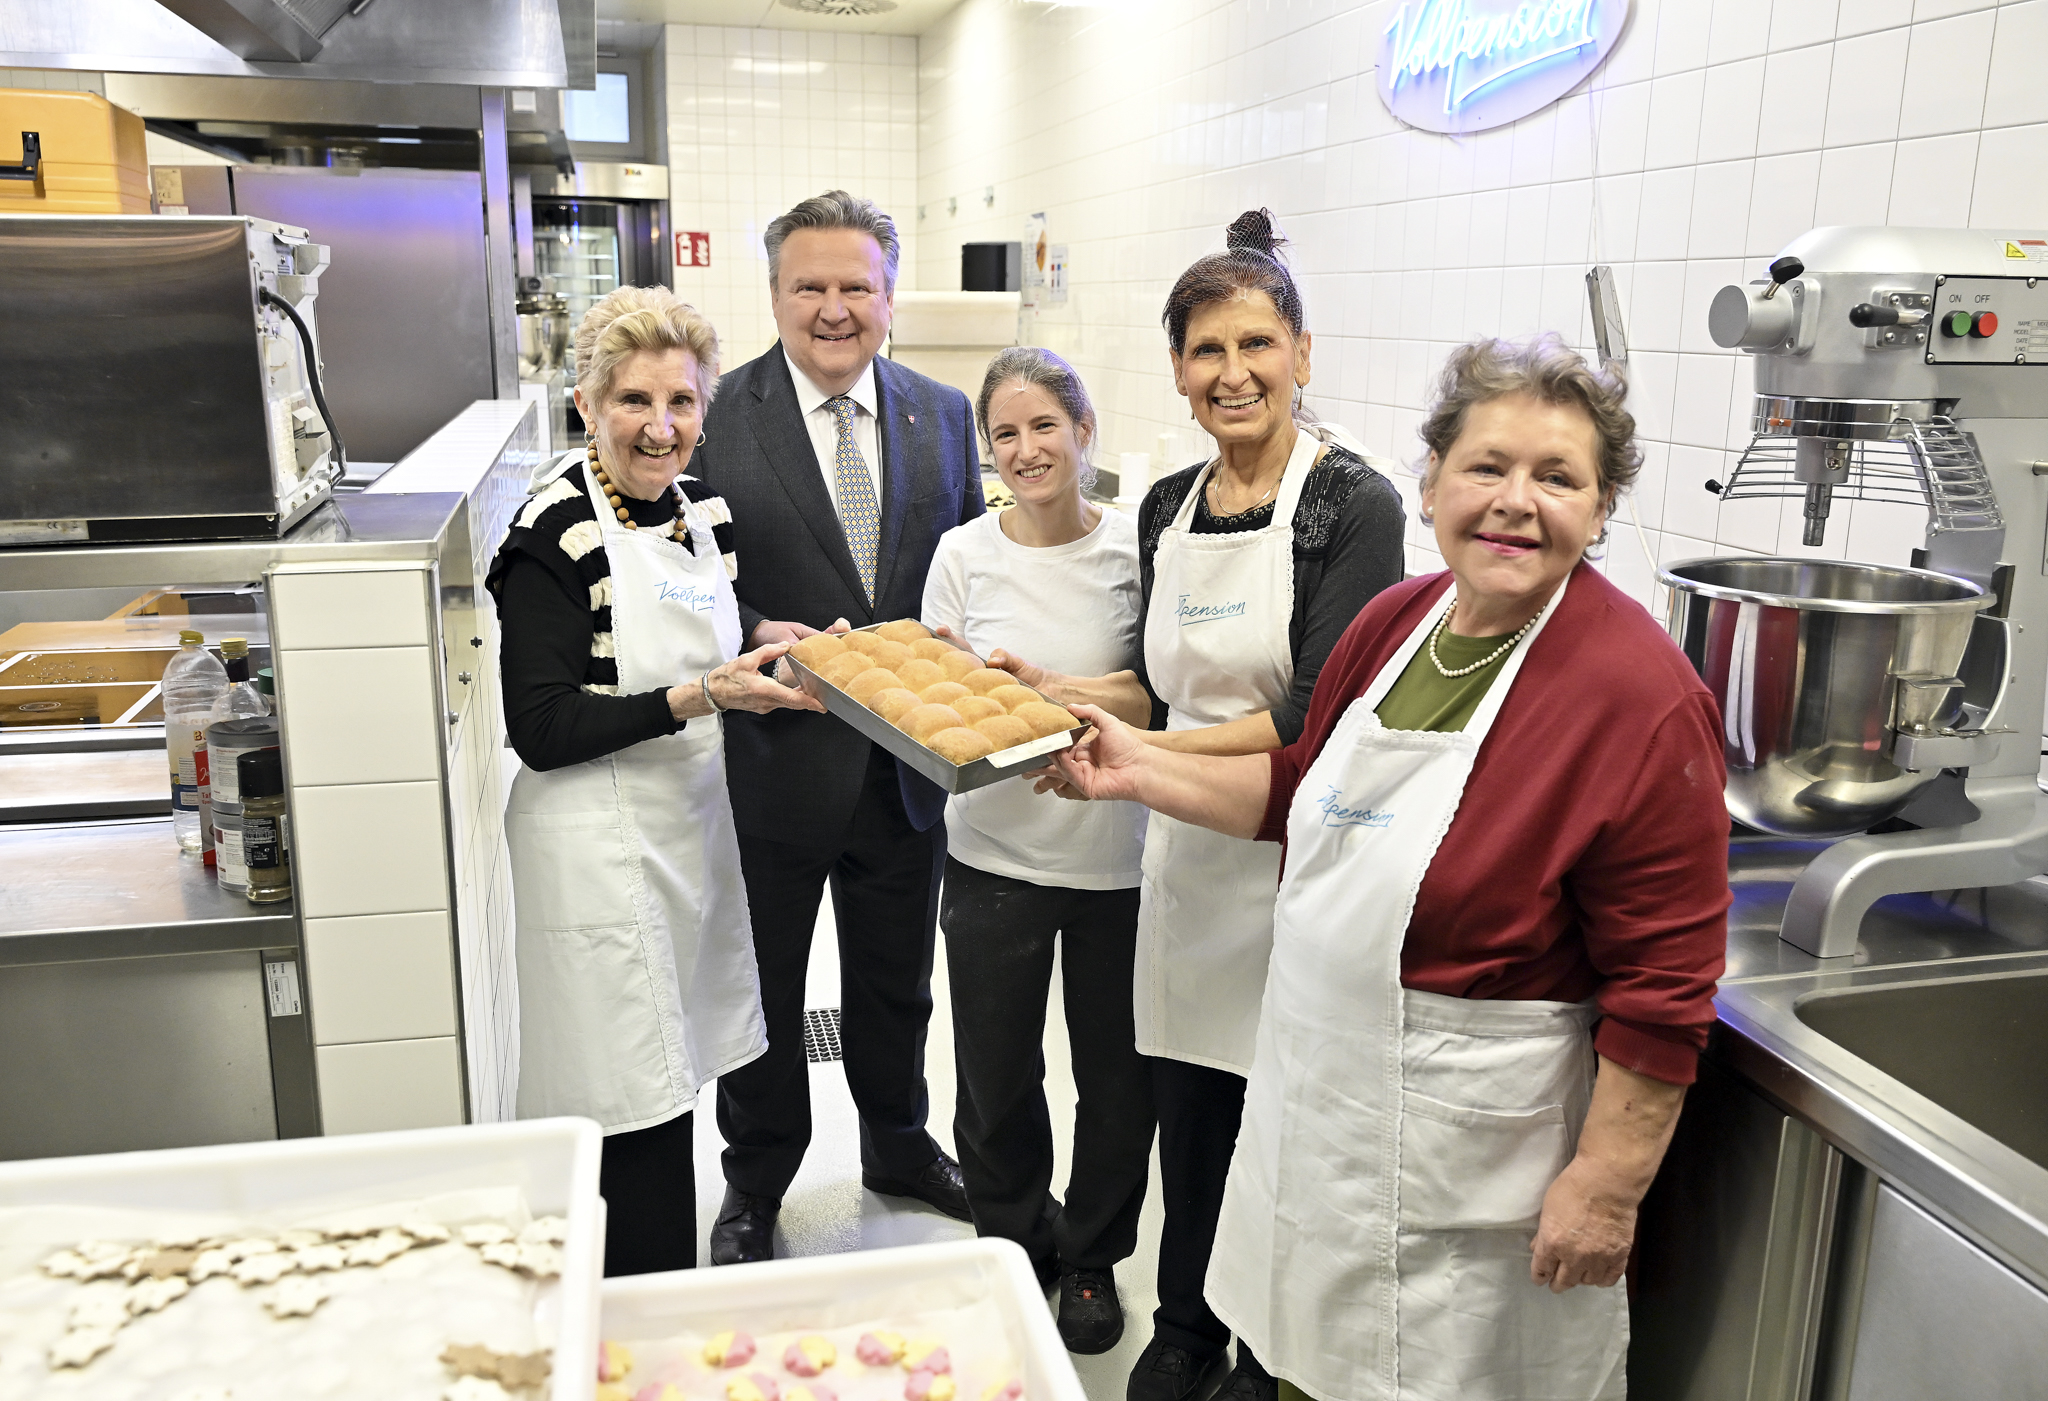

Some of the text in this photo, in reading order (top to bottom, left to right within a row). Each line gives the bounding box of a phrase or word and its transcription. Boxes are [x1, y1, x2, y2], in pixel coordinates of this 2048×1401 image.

[1949, 294, 1991, 303] ON OFF
[654, 580, 715, 612] Vollpen
